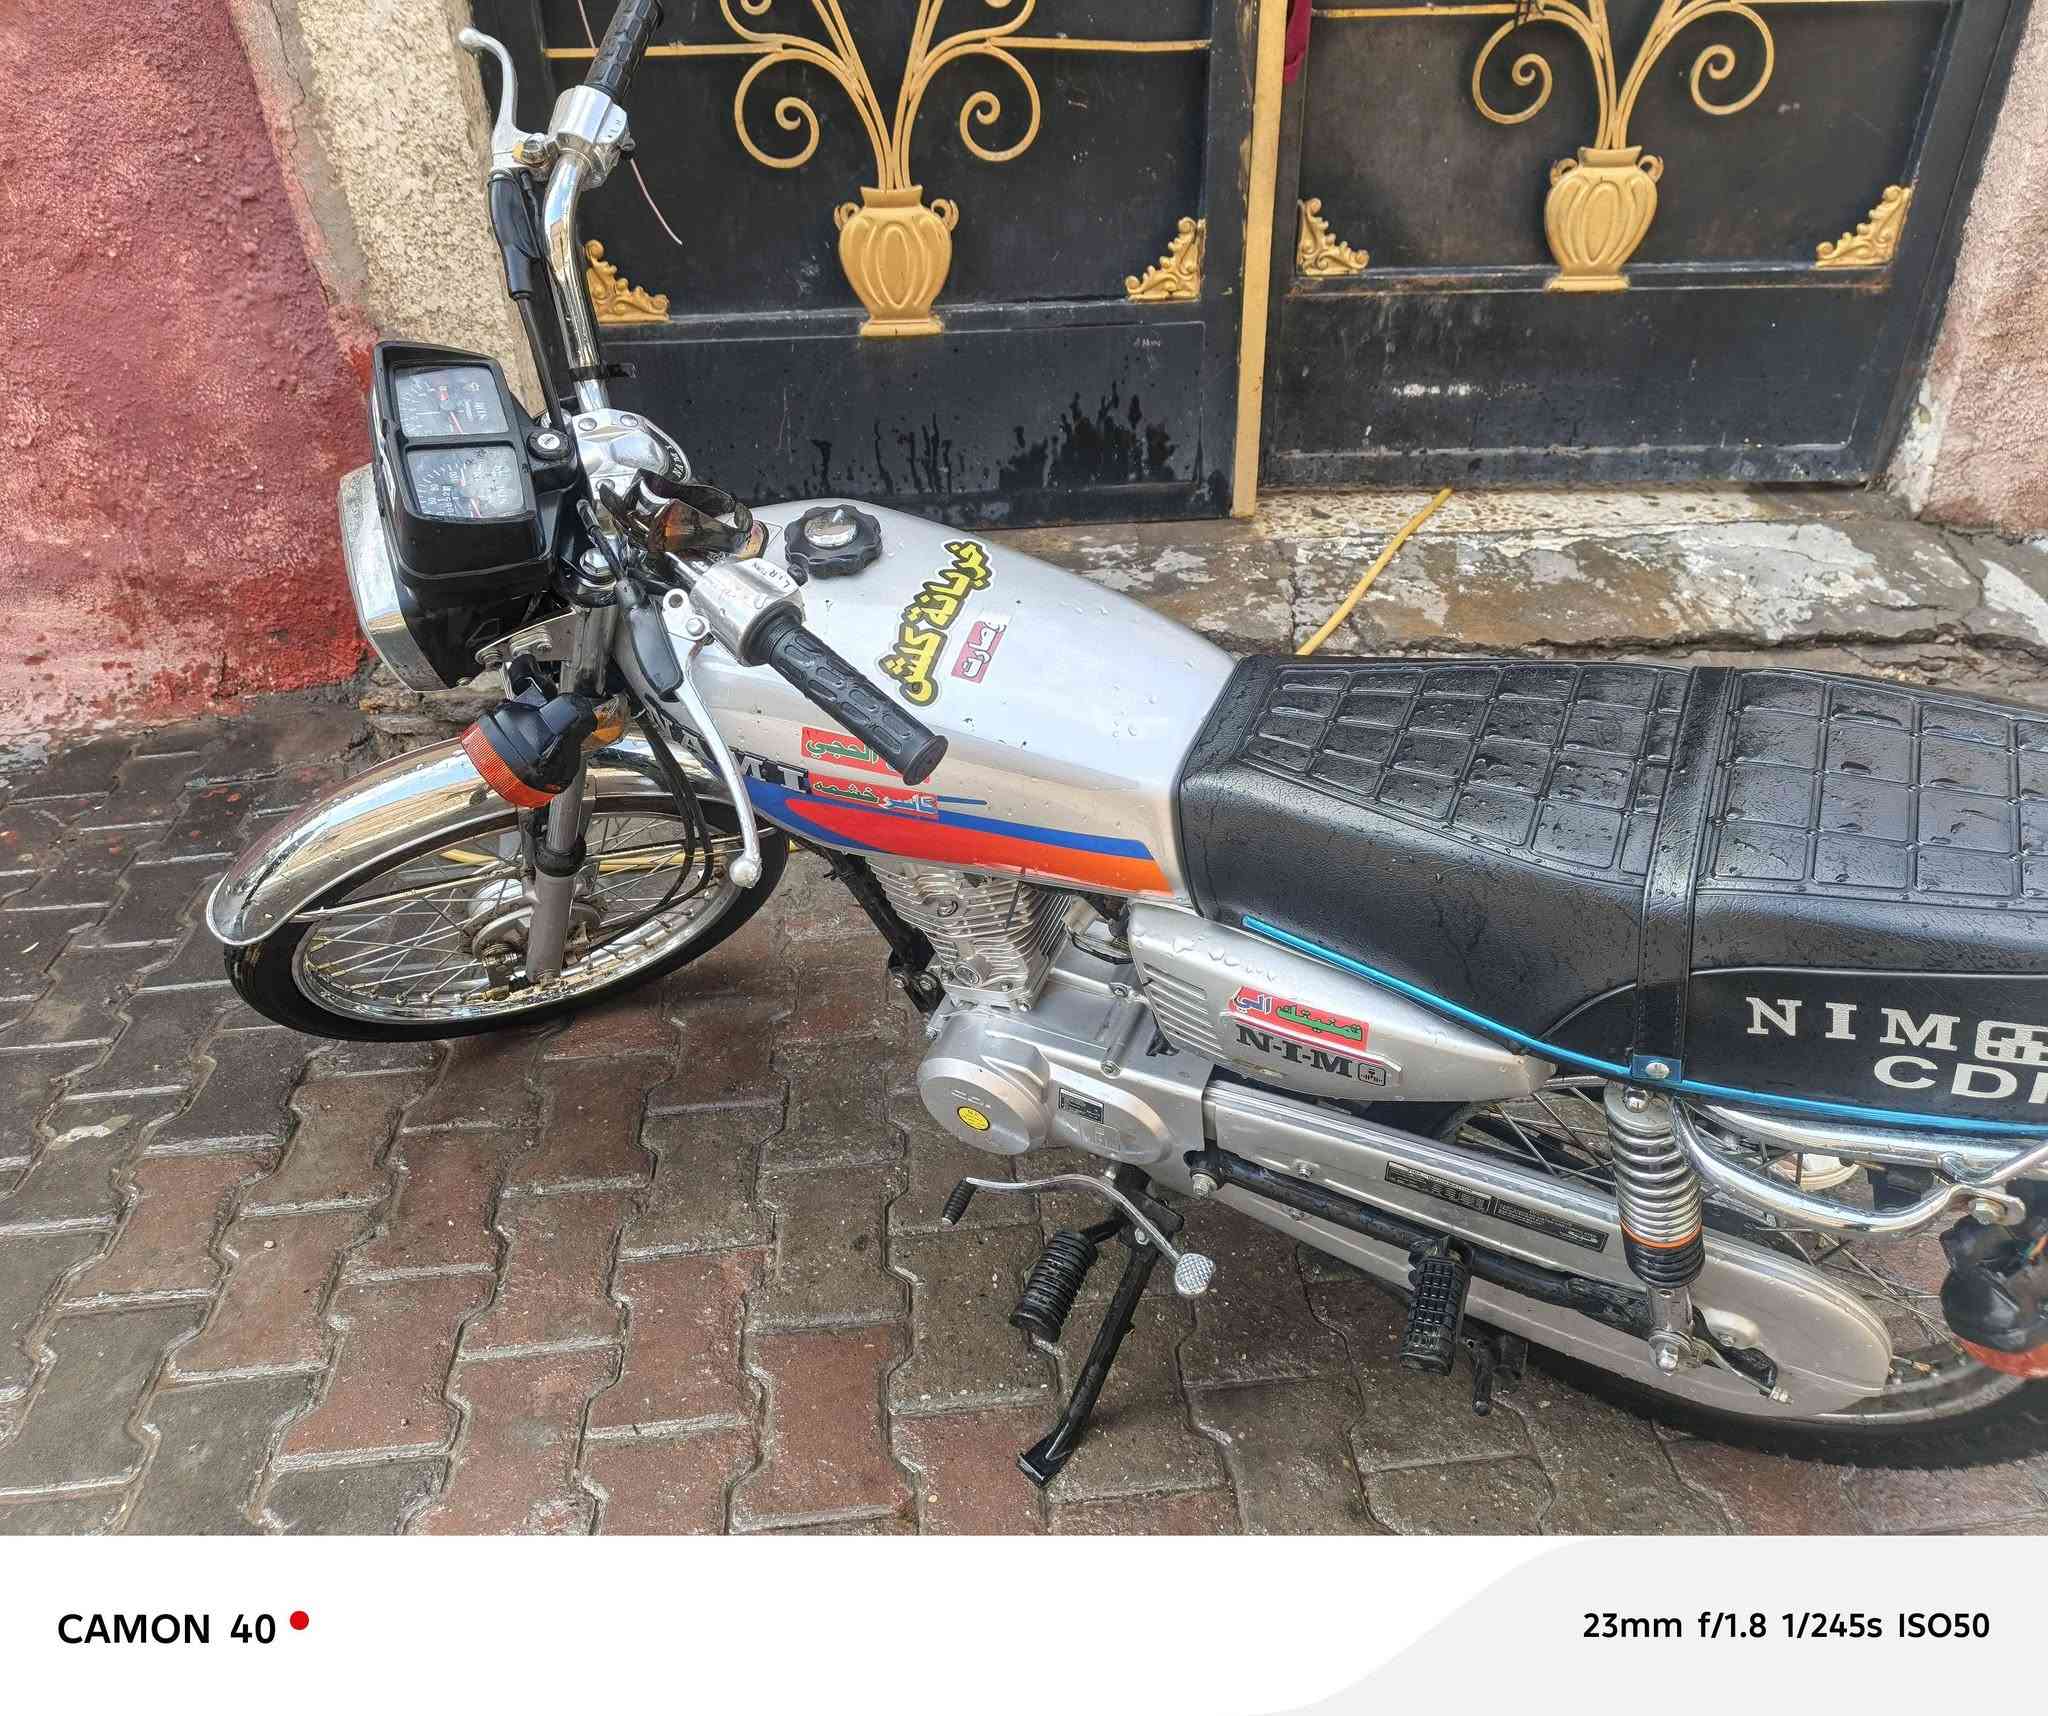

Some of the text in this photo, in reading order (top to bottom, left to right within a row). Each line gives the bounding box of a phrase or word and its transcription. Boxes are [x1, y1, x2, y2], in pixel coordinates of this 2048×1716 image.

[880, 541, 992, 706] خربانة كلش
[1236, 1023, 1354, 1079] N-I-M
